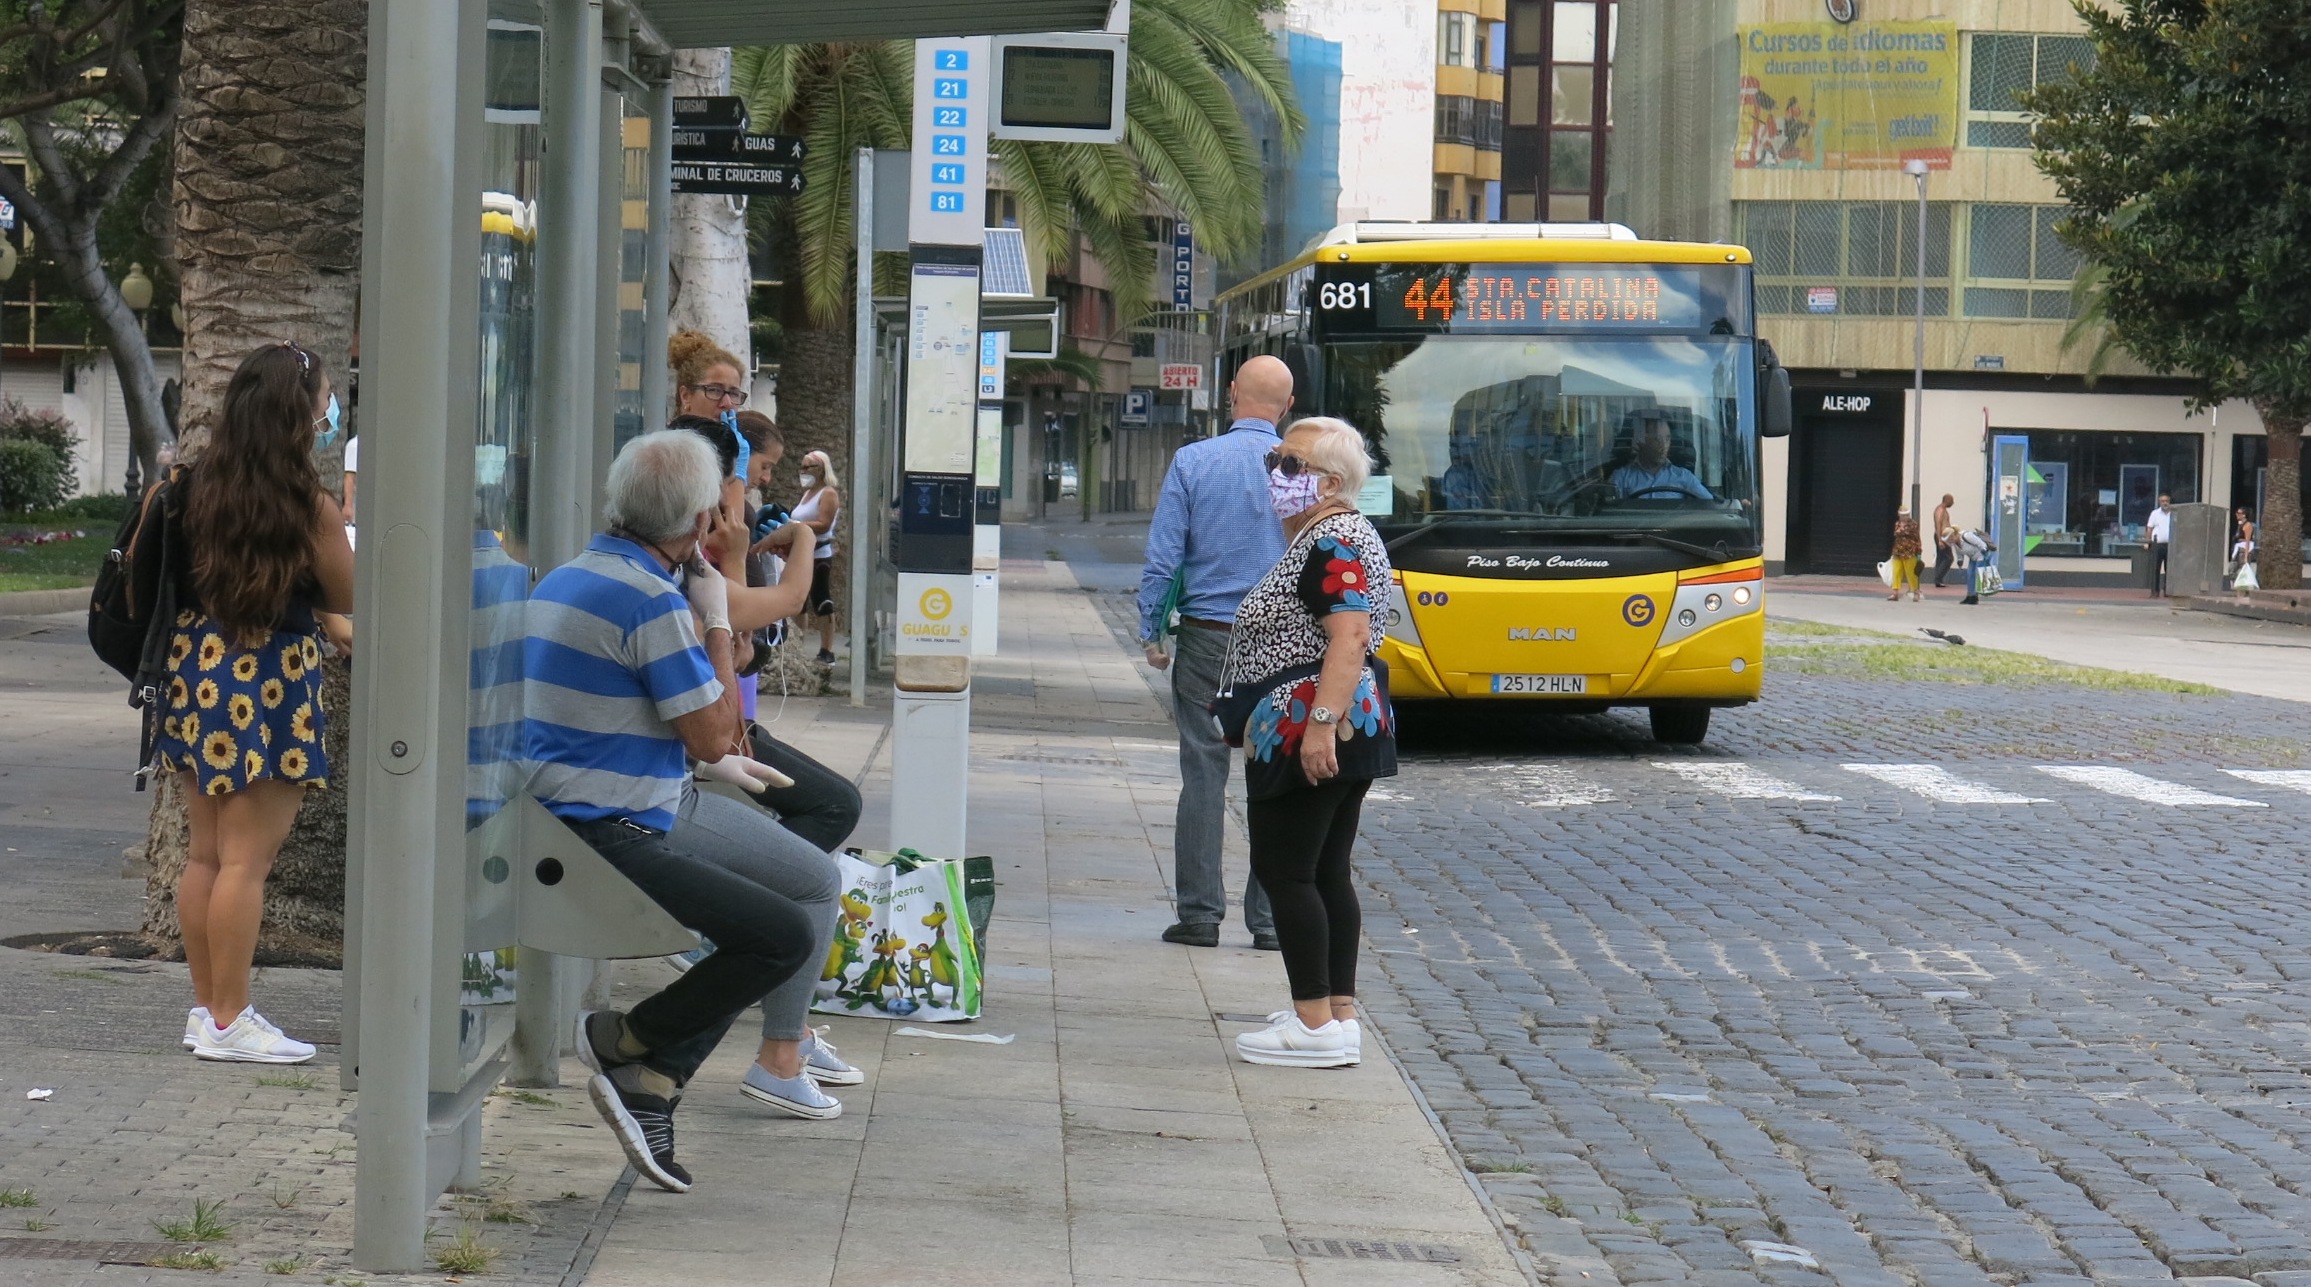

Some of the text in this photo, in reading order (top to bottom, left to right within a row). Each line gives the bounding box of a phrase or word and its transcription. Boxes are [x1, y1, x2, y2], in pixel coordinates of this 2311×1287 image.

[1749, 28, 1946, 53] Cursos de idiomas
[946, 54, 956, 68] 2
[1765, 57, 1928, 75] durante todo el año
[941, 83, 959, 96] 21
[674, 100, 708, 113] TURISMO
[940, 111, 960, 124] 22
[745, 137, 775, 150] GUAS
[939, 139, 959, 152] 24
[708, 168, 721, 181] DE
[726, 169, 782, 183] CRUCEROS
[938, 168, 956, 180] 41
[937, 196, 955, 209] 81
[1320, 282, 1370, 309] 681
[1405, 277, 1660, 320] 44 STA.CATALINA
[1466, 301, 1658, 320] ISLA PERDIDA
[1163, 366, 1198, 376] ABIERTO
[1163, 377, 1198, 387] 24 H
[1126, 394, 1143, 413] P
[1822, 396, 1871, 412] ALE-HOP
[1467, 556, 1609, 570] Piso Bajo Continuo
[902, 624, 968, 637] GUAGUS
[1508, 628, 1576, 641] MAN
[1504, 676, 1582, 692] 2512 HLN
